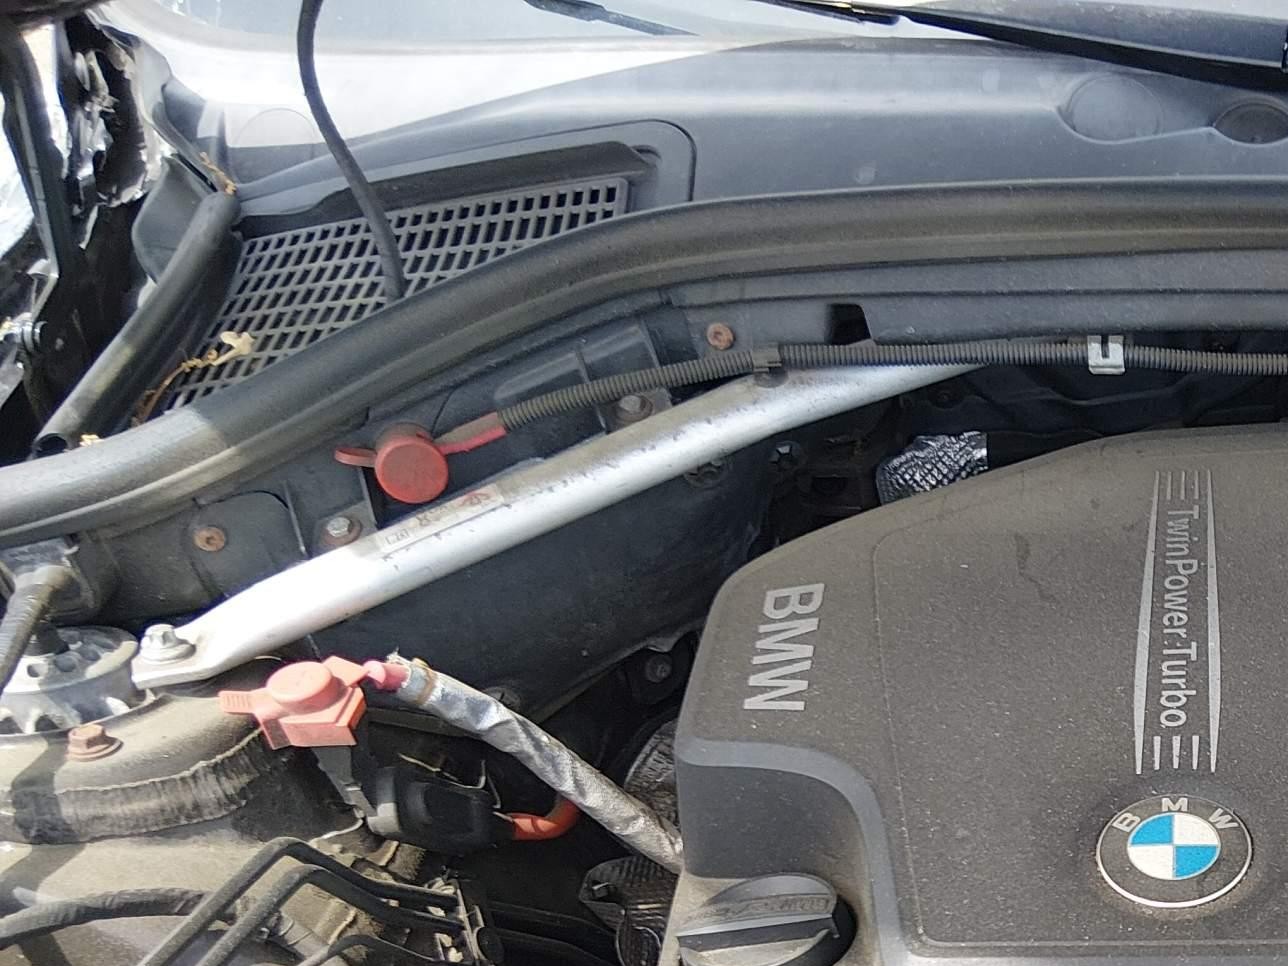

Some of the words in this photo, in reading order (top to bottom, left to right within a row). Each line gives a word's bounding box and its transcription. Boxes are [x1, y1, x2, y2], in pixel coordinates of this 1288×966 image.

[1161, 504, 1200, 637] TwinPower
[743, 582, 825, 711] BMW
[1159, 641, 1198, 728] Turbo
[1111, 797, 1240, 833] BMW
